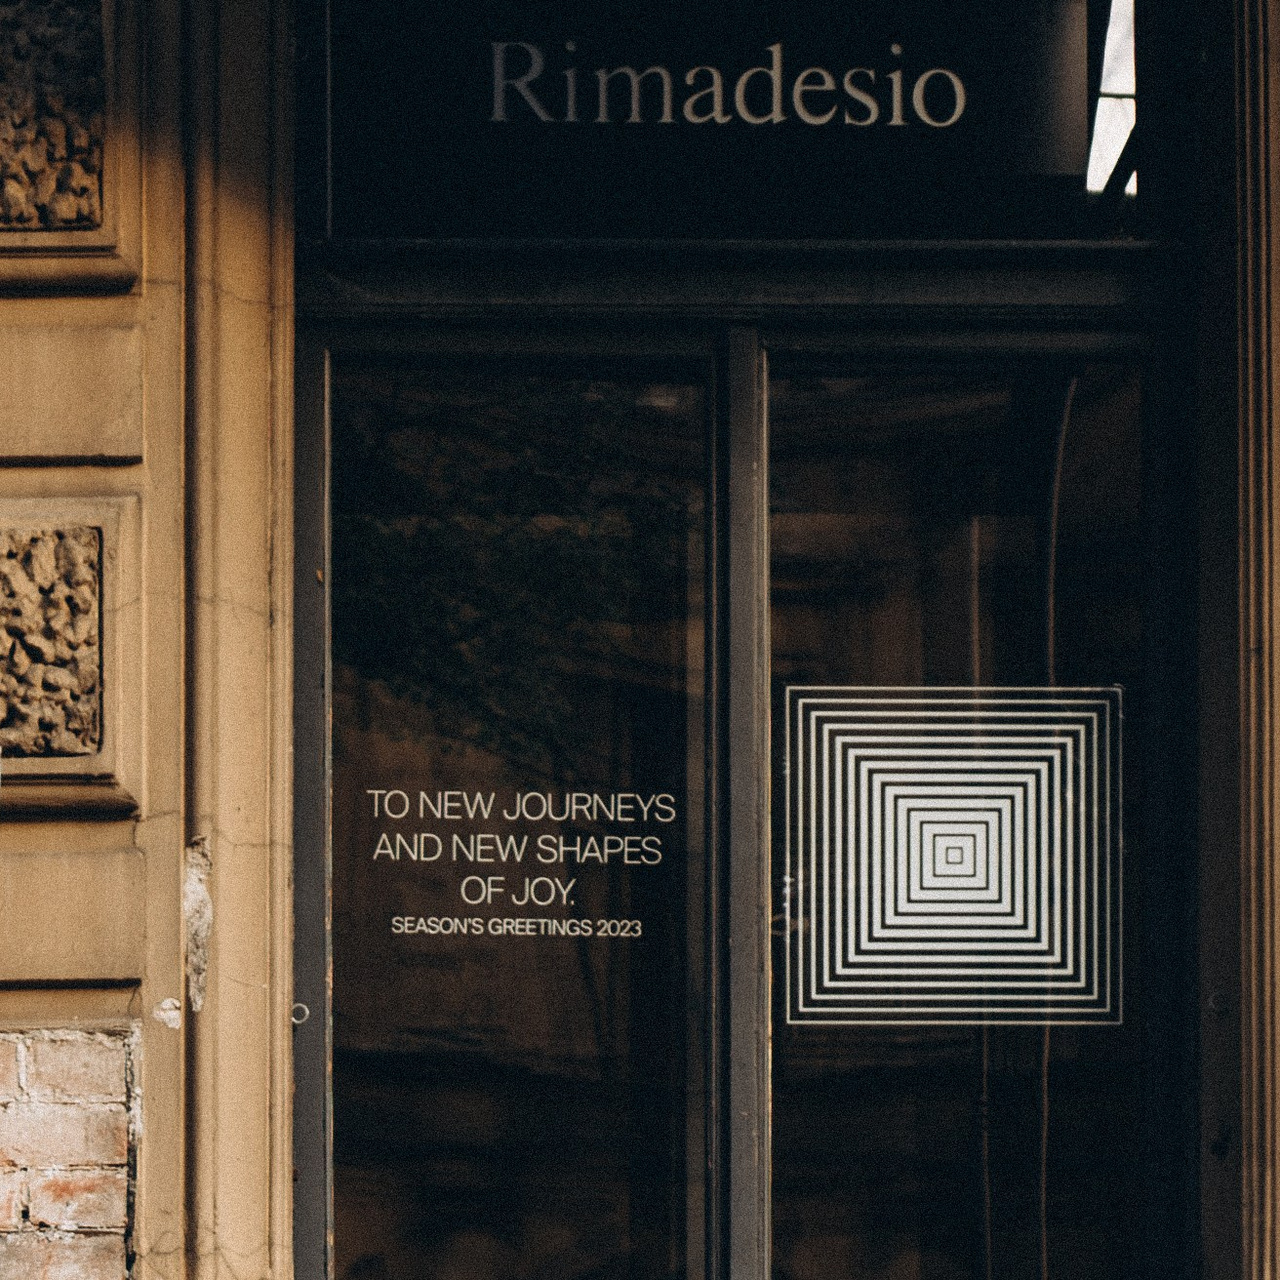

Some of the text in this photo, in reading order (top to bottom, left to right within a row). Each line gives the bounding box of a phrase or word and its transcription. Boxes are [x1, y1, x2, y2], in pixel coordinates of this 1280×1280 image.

[489, 40, 968, 129] Rimadesio
[366, 789, 677, 823] TO NEW JOURNEYS
[373, 832, 663, 866] AND NEW SHAPES
[460, 875, 576, 906] OF JOY.
[391, 916, 642, 938] SEASON'S GREETINGS 2023
